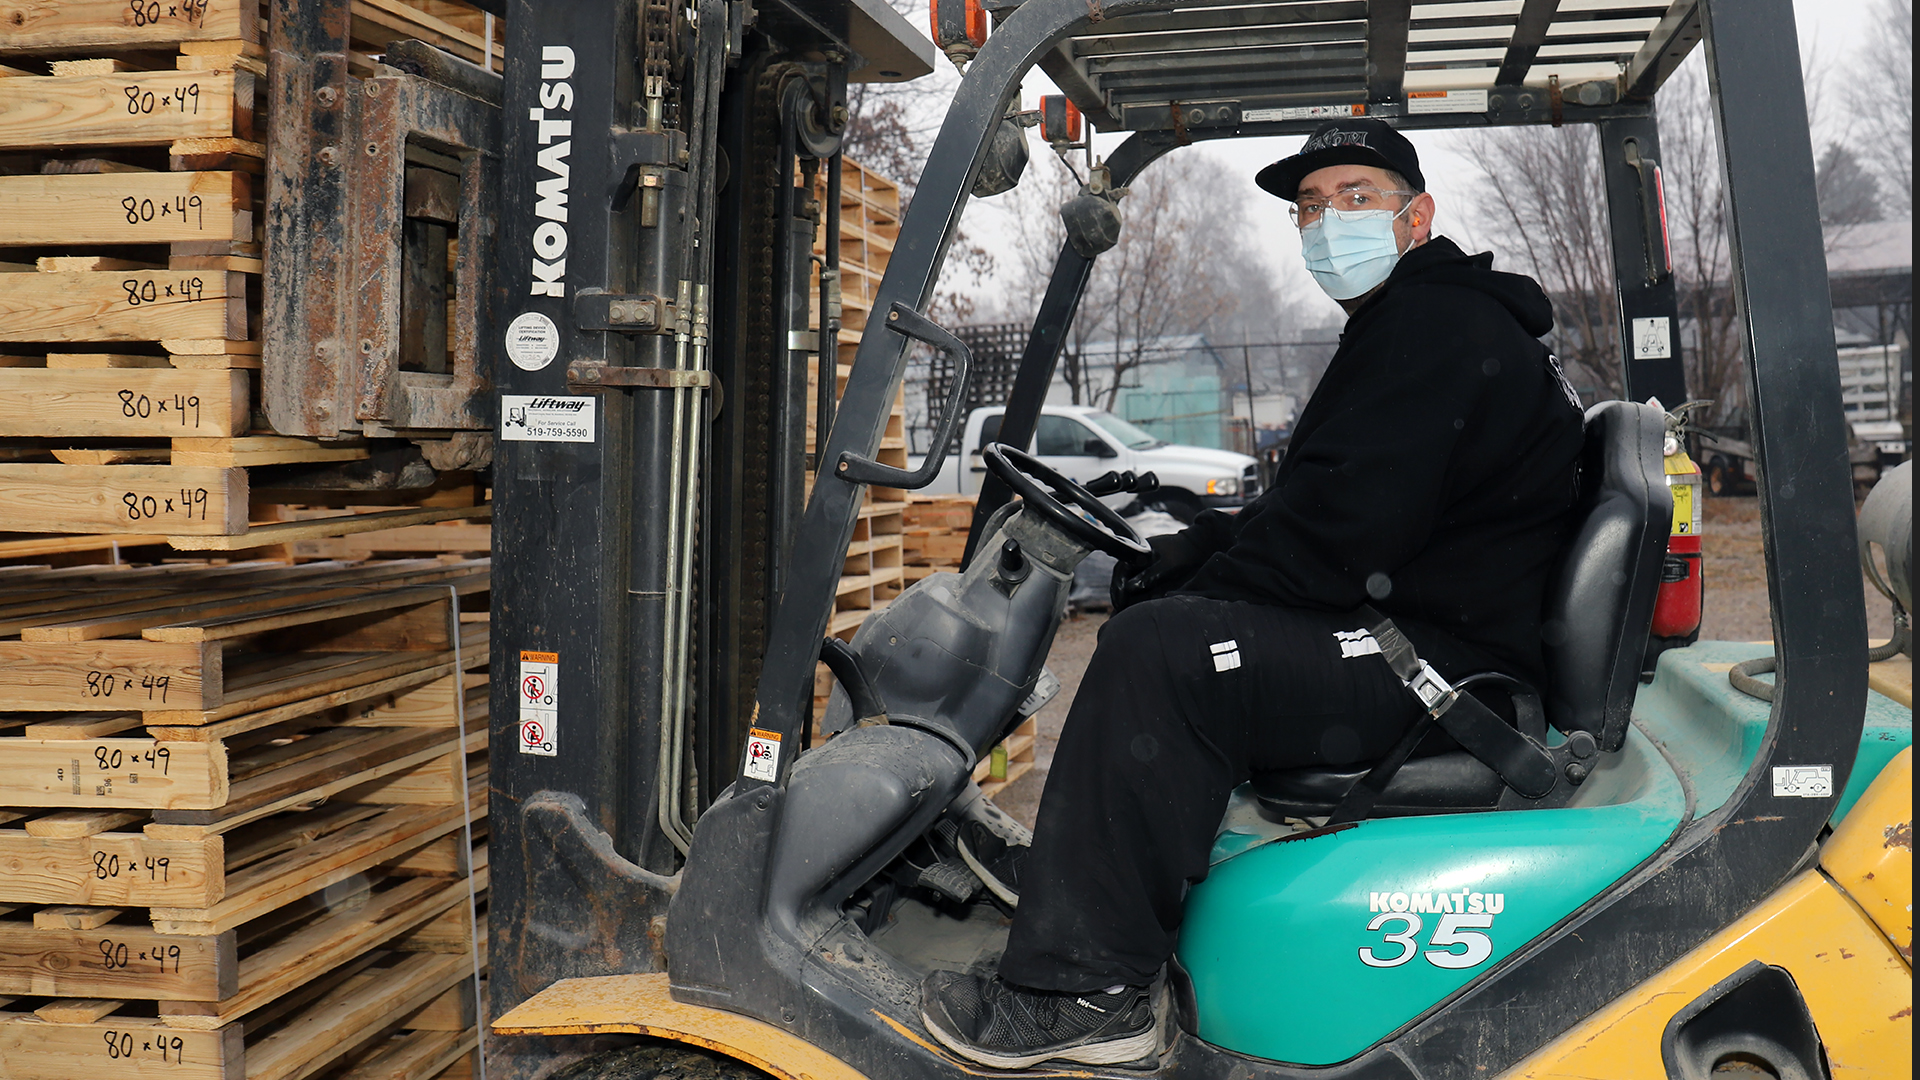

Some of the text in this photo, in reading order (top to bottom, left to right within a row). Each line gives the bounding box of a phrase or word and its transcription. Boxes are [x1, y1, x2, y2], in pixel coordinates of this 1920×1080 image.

[530, 46, 575, 297] KOMATSU
[529, 398, 585, 412] Liftway
[527, 427, 587, 437] 519-759-5590
[529, 654, 555, 662] WARNING
[756, 730, 779, 741] WARNING
[1369, 888, 1504, 914] KOMATSU
[1358, 911, 1495, 969] 35
